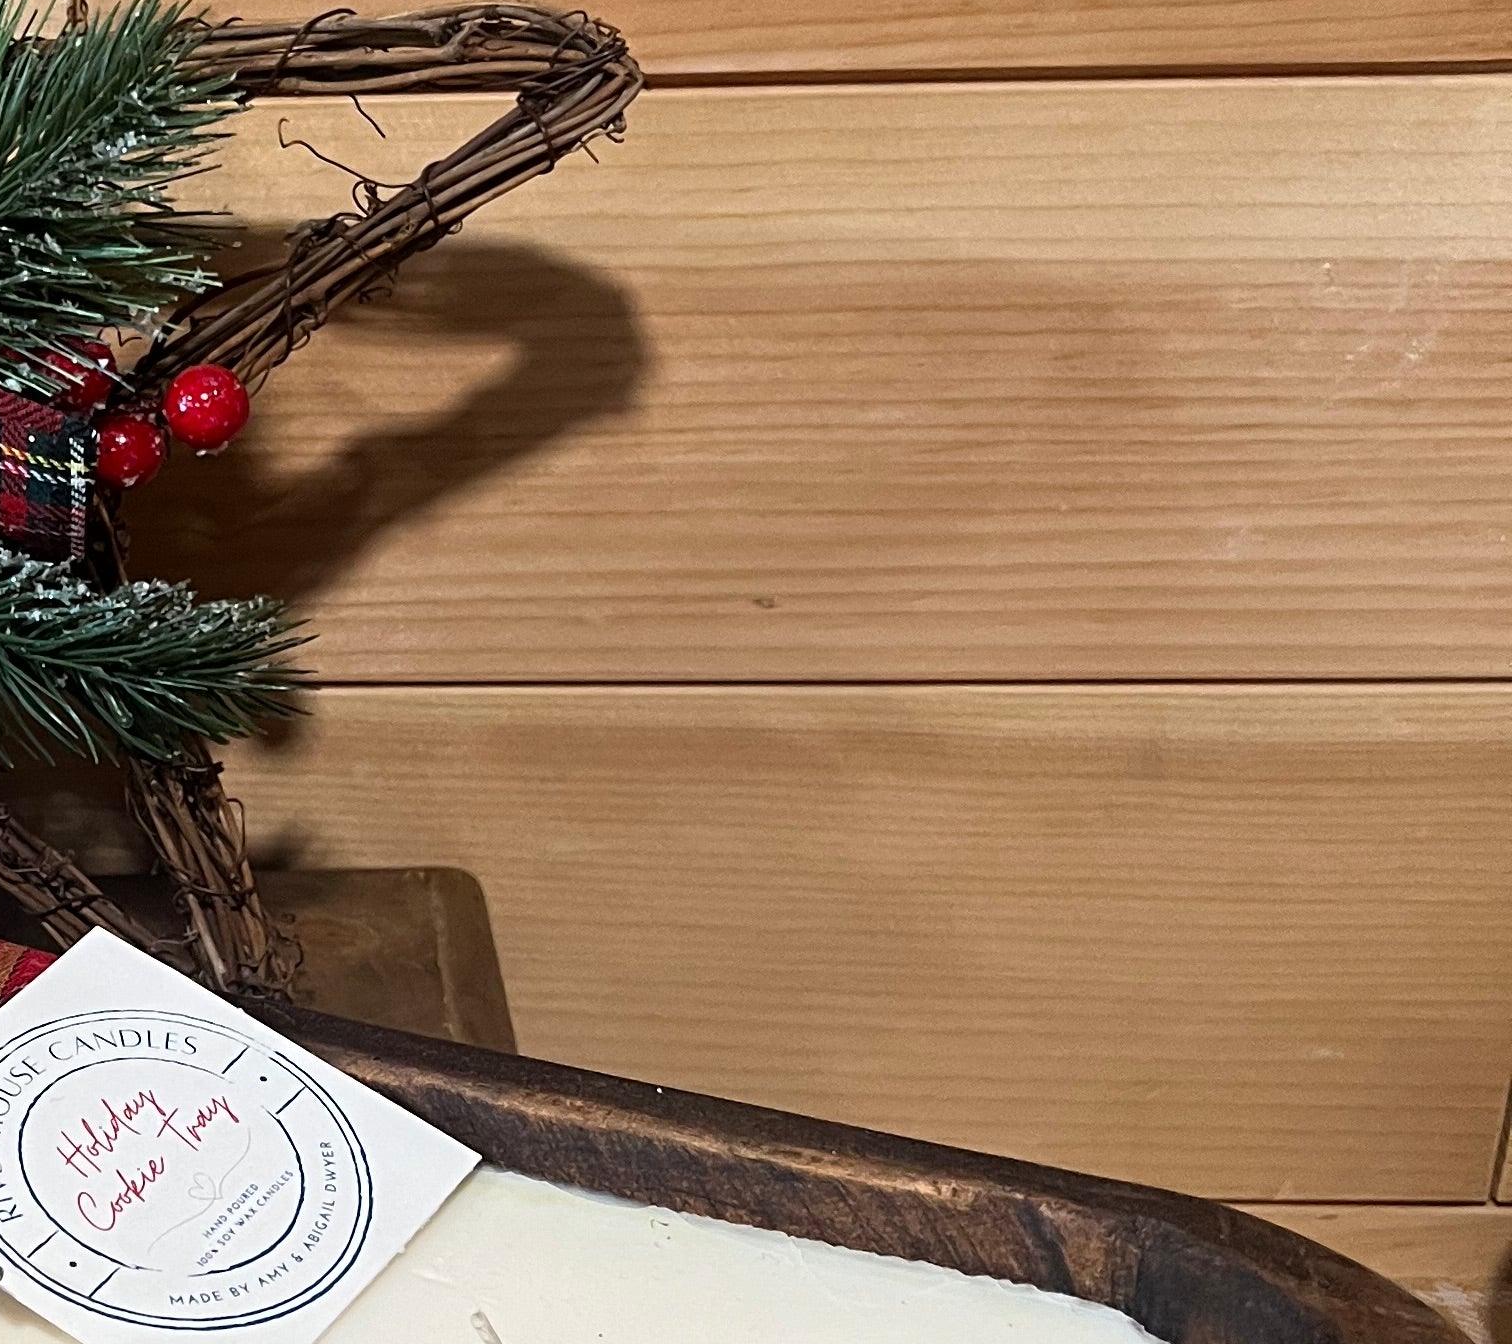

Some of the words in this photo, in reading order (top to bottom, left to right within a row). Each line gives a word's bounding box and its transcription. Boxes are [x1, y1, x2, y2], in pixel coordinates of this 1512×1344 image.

[48, 1029, 198, 1061] CANDLES
[56, 1089, 167, 1178] Holiday
[77, 1156, 165, 1232] Cookie
[156, 1095, 240, 1152] Tray
[169, 1290, 224, 1308] MADE
[228, 1281, 250, 1298] BY
[257, 1262, 290, 1288] AMY
[290, 1252, 304, 1264] &
[302, 1199, 336, 1252] ABIGAIL
[319, 1140, 337, 1193] DWYER
[202, 1214, 228, 1239] HAND
[226, 1182, 260, 1215] POURED
[216, 1227, 236, 1246] SOY
[234, 1207, 258, 1227] WAX
[256, 1169, 294, 1207] CANDLES
